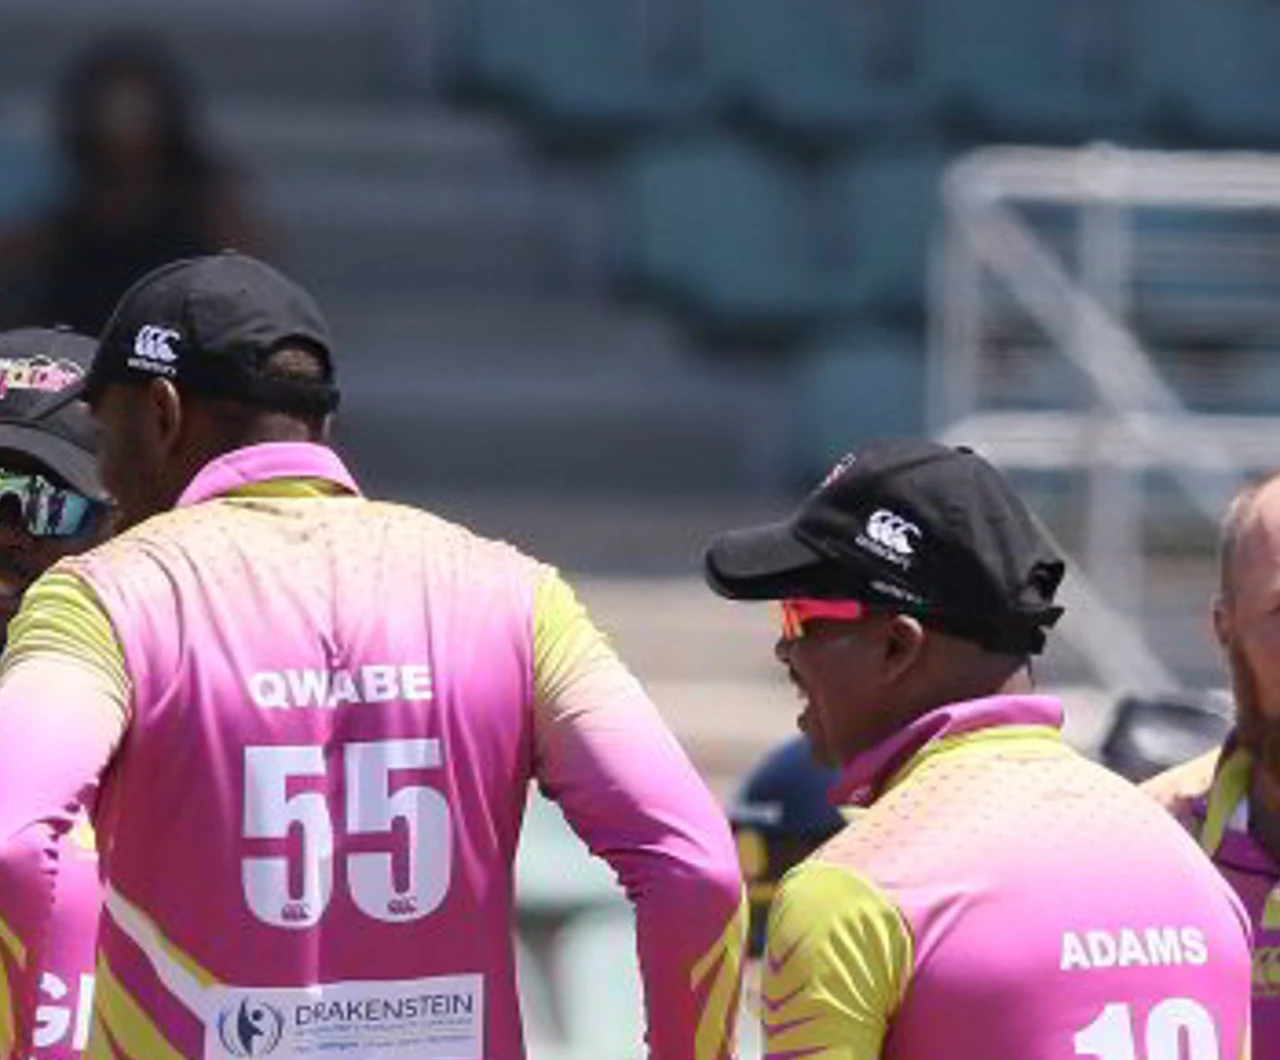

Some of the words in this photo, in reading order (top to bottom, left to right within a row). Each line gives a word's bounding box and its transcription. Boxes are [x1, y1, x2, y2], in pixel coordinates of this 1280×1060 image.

[249, 665, 432, 709] QWABE
[241, 738, 452, 929] 55
[1060, 926, 1209, 971] ADAMS
[294, 993, 475, 1026] DRAKENSTEIN
